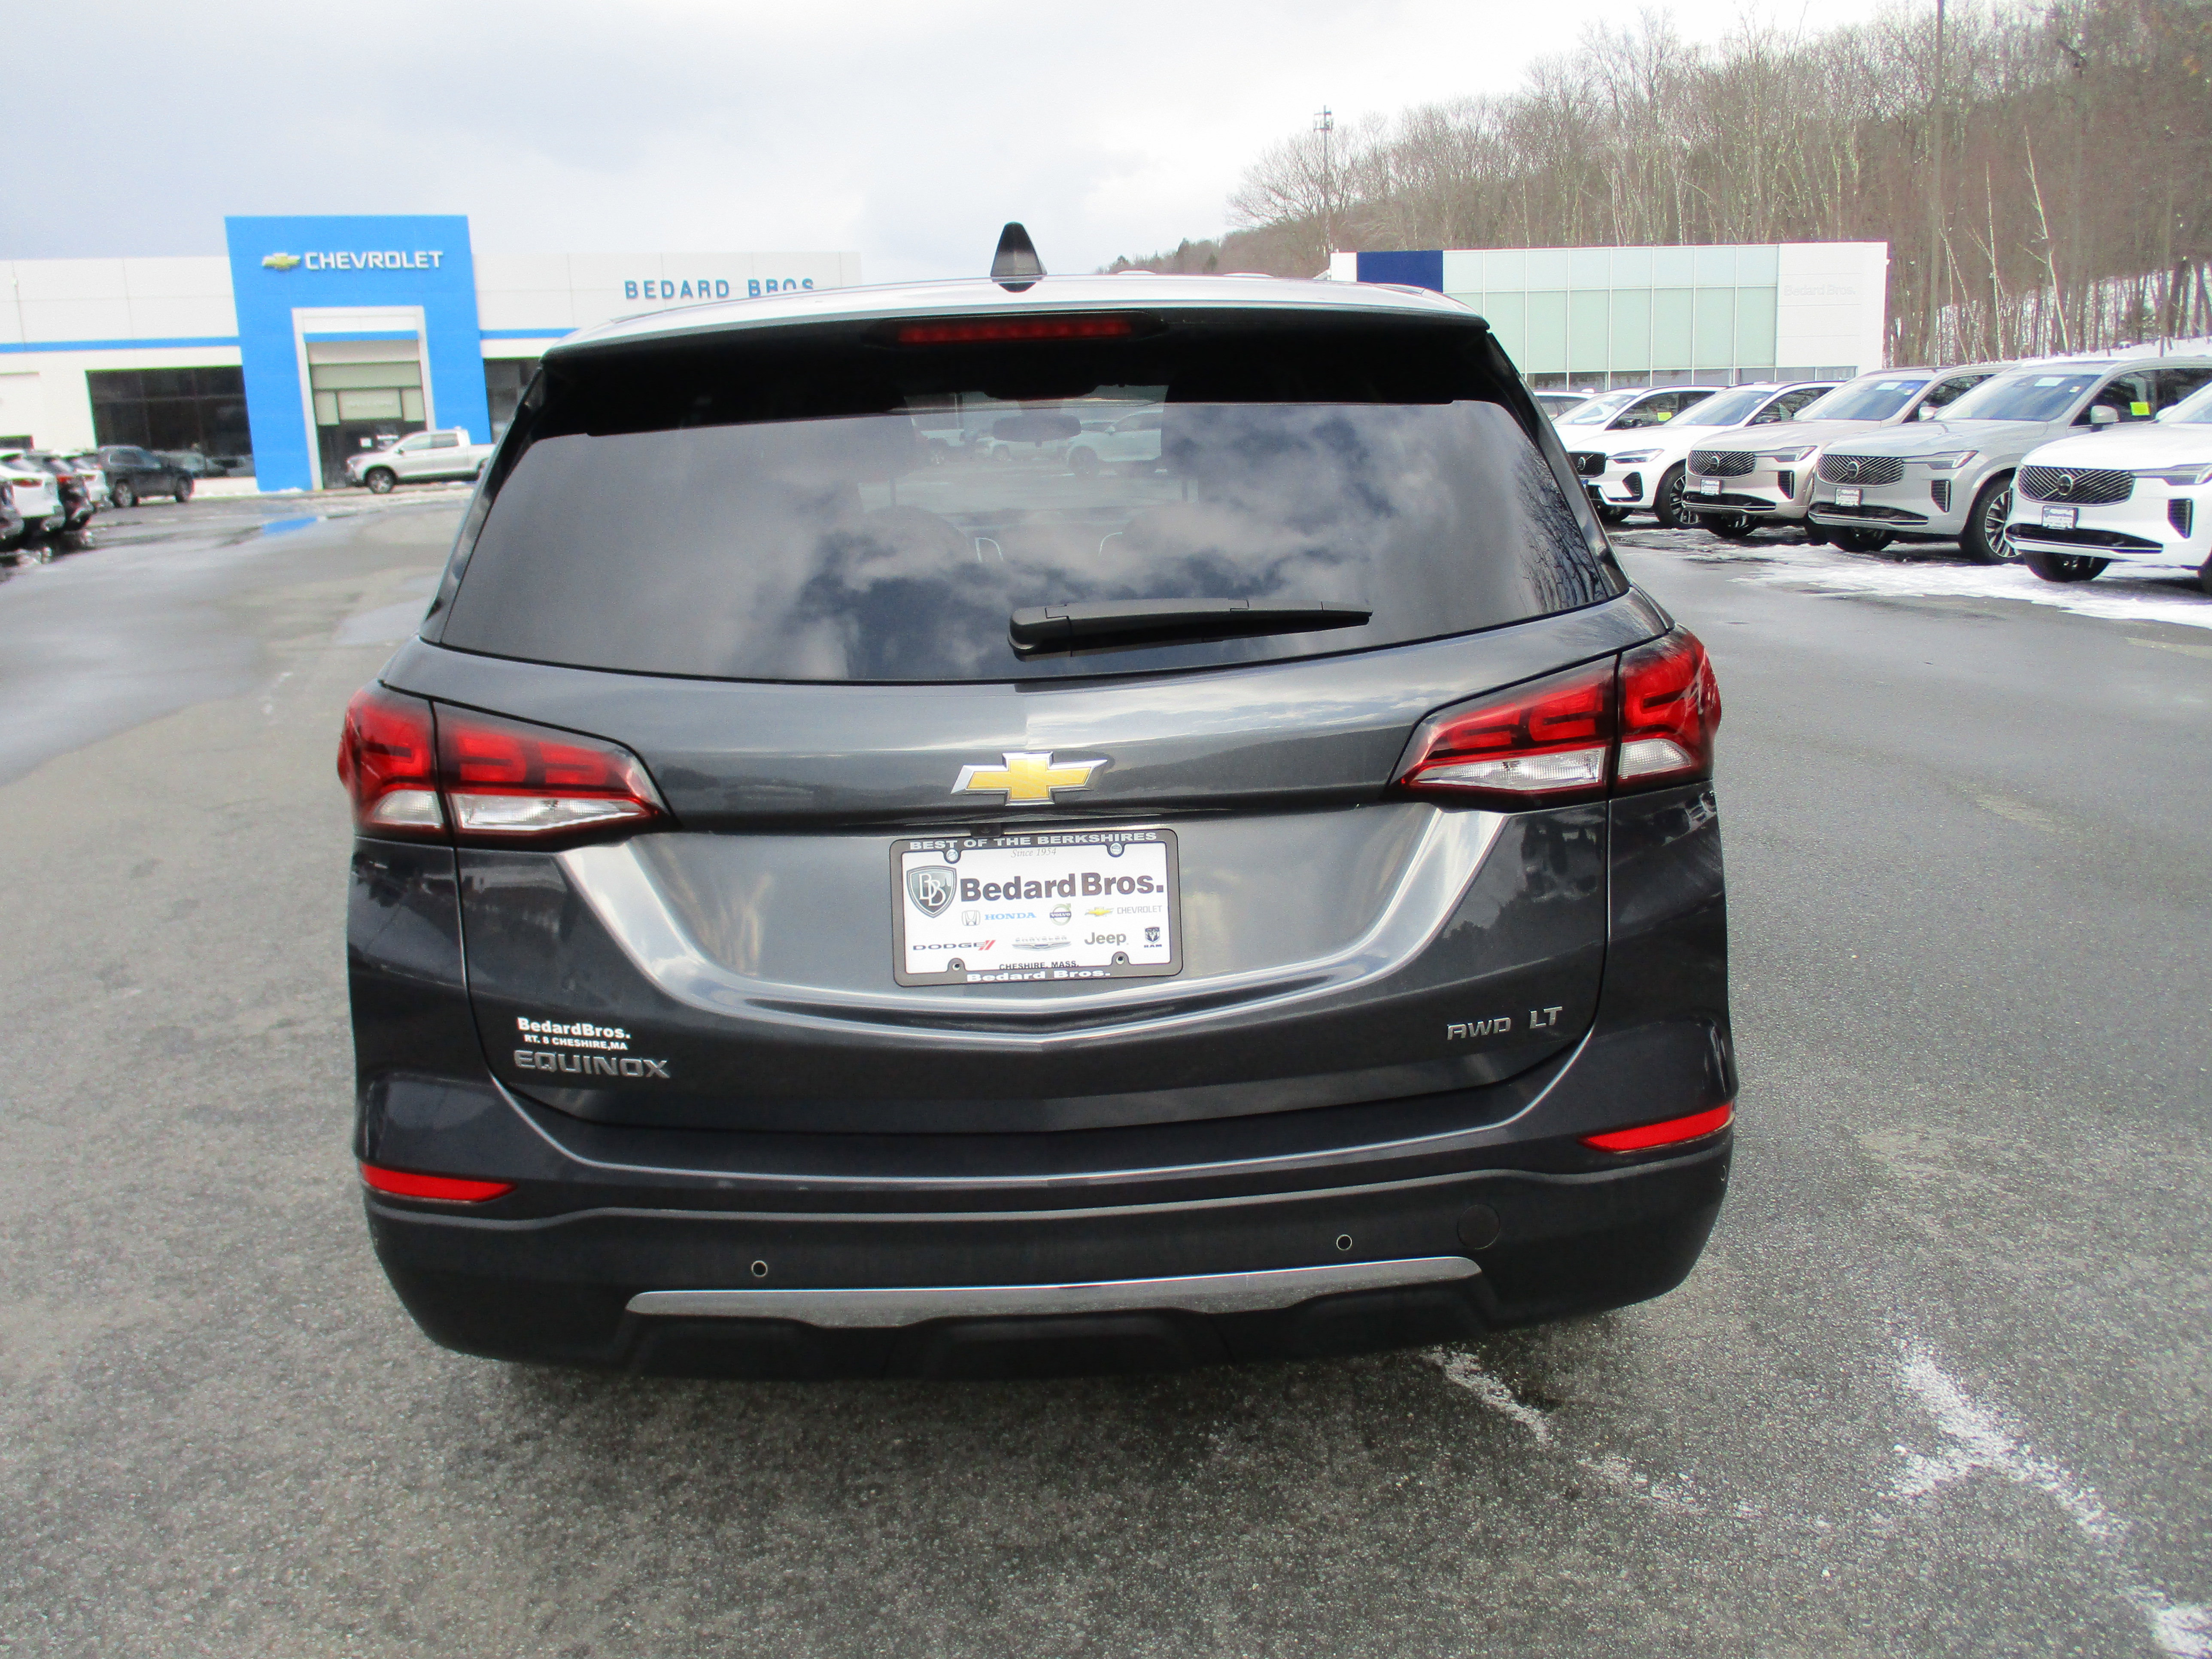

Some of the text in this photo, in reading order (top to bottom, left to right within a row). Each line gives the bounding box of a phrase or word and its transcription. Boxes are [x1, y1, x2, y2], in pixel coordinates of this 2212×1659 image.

[305, 251, 443, 270] CHEVROLET
[624, 280, 730, 300] BEDARD
[910, 833, 1157, 850] BEST OF THE BERKSHIRES
[1011, 848, 1057, 858] Since 1954
[960, 872, 1164, 902] Bedard Bros.
[1117, 905, 1162, 914] CHEVROLET
[913, 942, 986, 950] DODGE
[1085, 932, 1126, 946] Jeep
[967, 970, 1111, 982] Bedard Bros.
[1447, 1006, 1563, 1040] AWD LT
[523, 1034, 540, 1044] RT.
[542, 1036, 549, 1045] 8
[514, 1050, 670, 1079] EQUINOX
